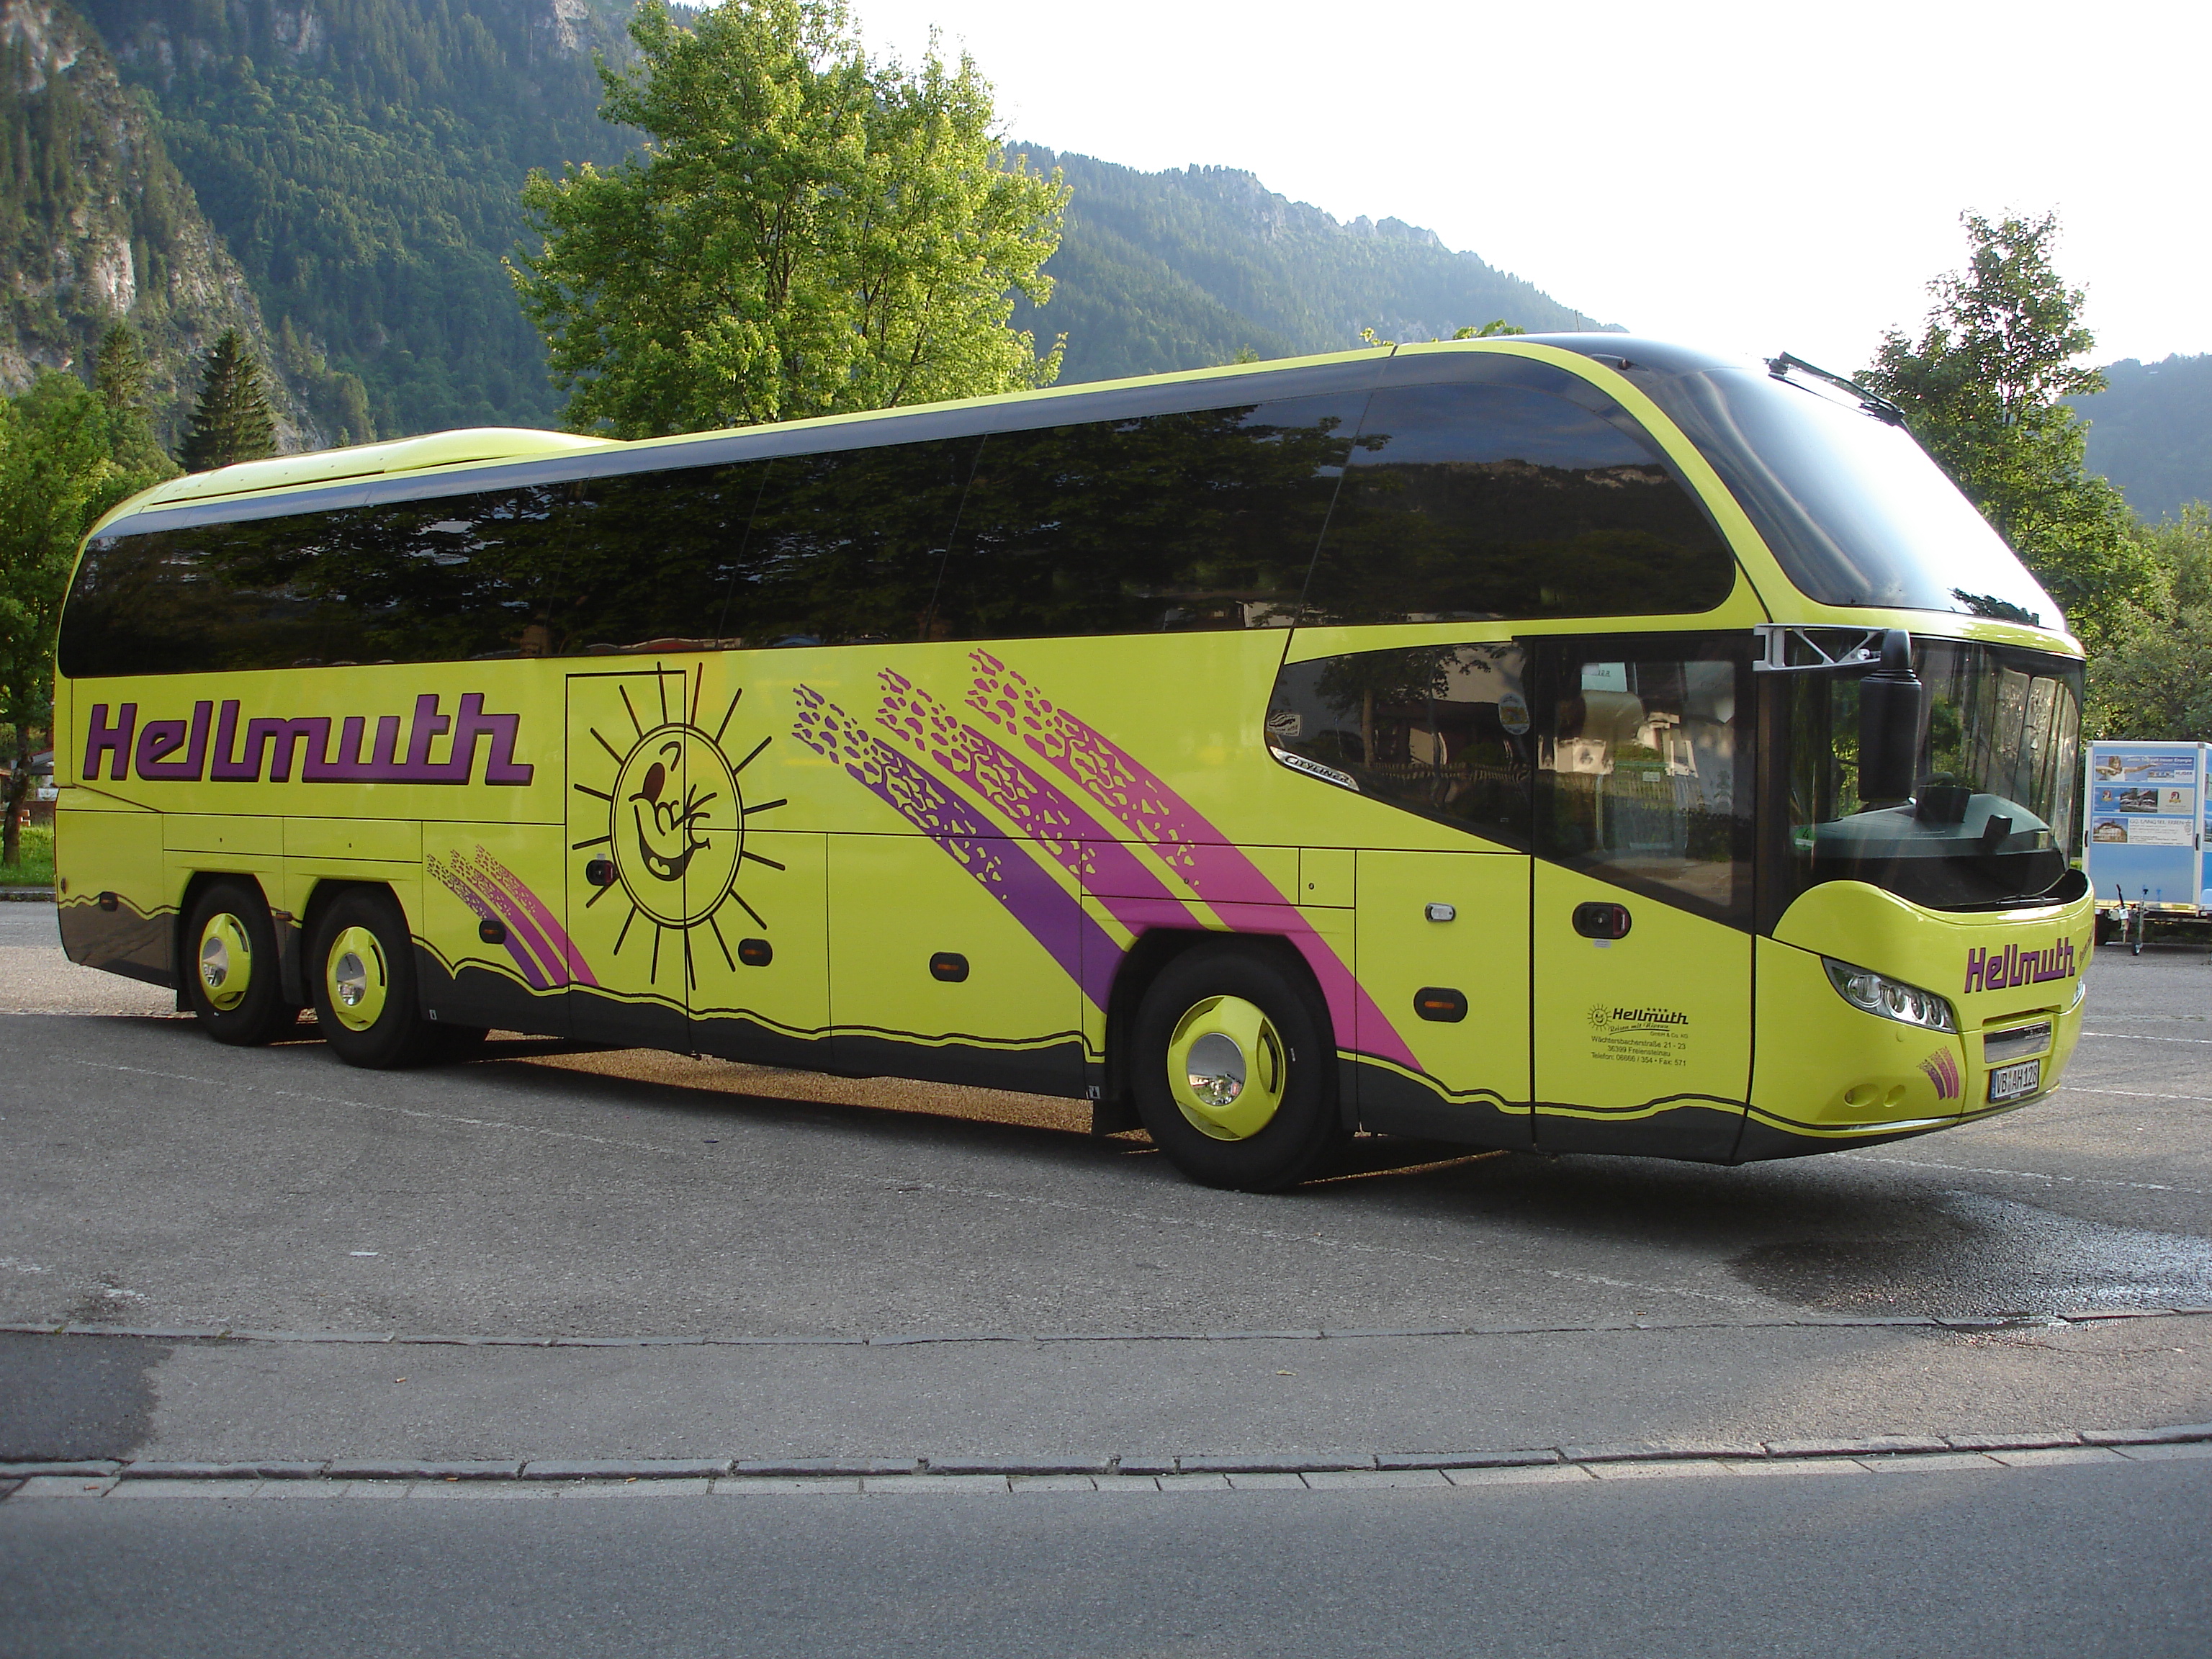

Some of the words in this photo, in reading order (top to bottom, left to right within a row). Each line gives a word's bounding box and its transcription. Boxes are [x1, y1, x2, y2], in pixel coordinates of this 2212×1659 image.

[82, 693, 535, 786] Hellmuth
[1964, 937, 2075, 994] Hellmuth
[1612, 1008, 1689, 1025] Hellmuth
[1997, 1072, 2008, 1094] VB
[2012, 1069, 2023, 1090] AH
